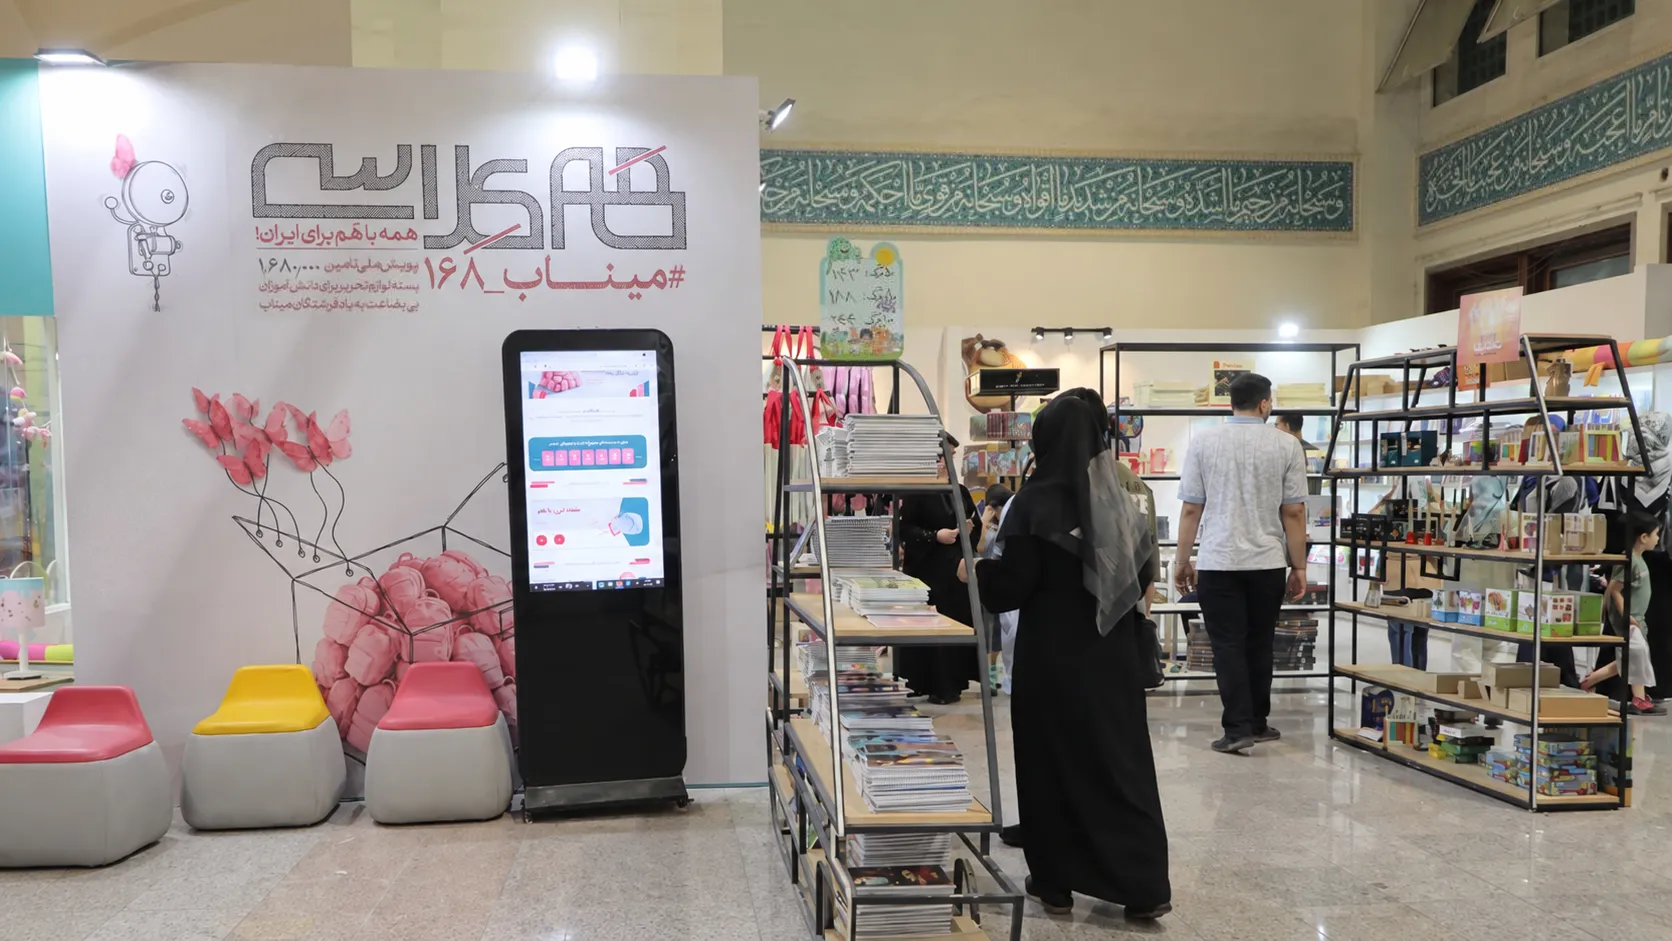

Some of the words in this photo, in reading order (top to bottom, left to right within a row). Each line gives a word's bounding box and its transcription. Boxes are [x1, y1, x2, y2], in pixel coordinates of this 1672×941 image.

[255, 224, 300, 247] ایران!
[301, 224, 334, 247] برای
[364, 224, 377, 246] با
[380, 227, 418, 241] همه
[357, 258, 381, 273] ملی
[381, 258, 419, 274] پویش
[319, 280, 339, 293] برای
[335, 281, 369, 293] تحریر
[368, 280, 392, 293] لوازم
[392, 281, 419, 293] بسته
[259, 298, 292, 312] میناب
[292, 297, 339, 312] فرشتگان
[339, 299, 353, 312] یاد
[355, 301, 364, 312] به
